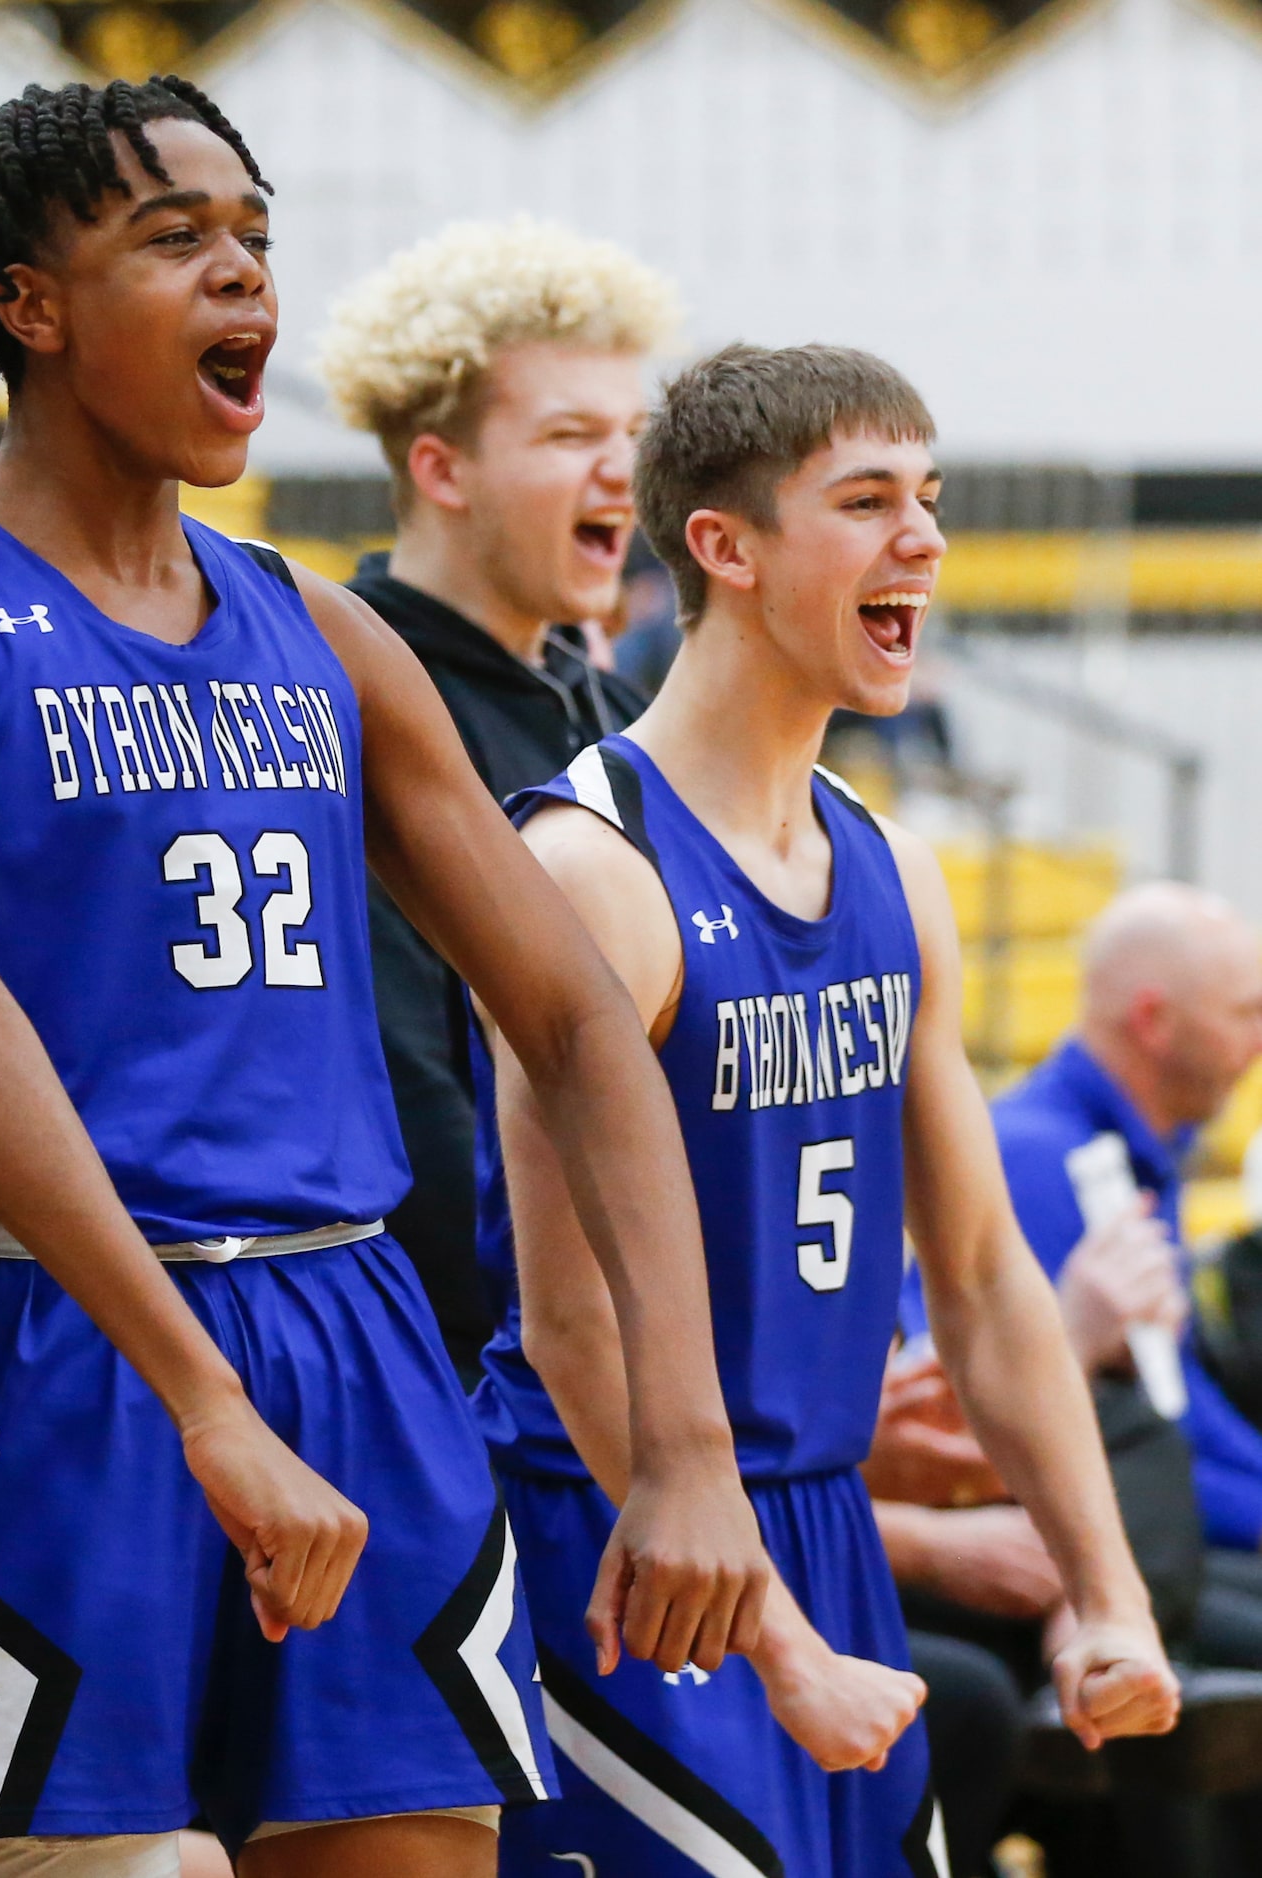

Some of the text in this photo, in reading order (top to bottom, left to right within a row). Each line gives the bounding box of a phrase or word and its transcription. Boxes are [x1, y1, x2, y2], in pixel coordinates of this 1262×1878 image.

[33, 679, 348, 802] BYRON NELSON
[162, 830, 326, 990] 32
[710, 993, 814, 1113] BYRON
[795, 1137, 855, 1292] 5
